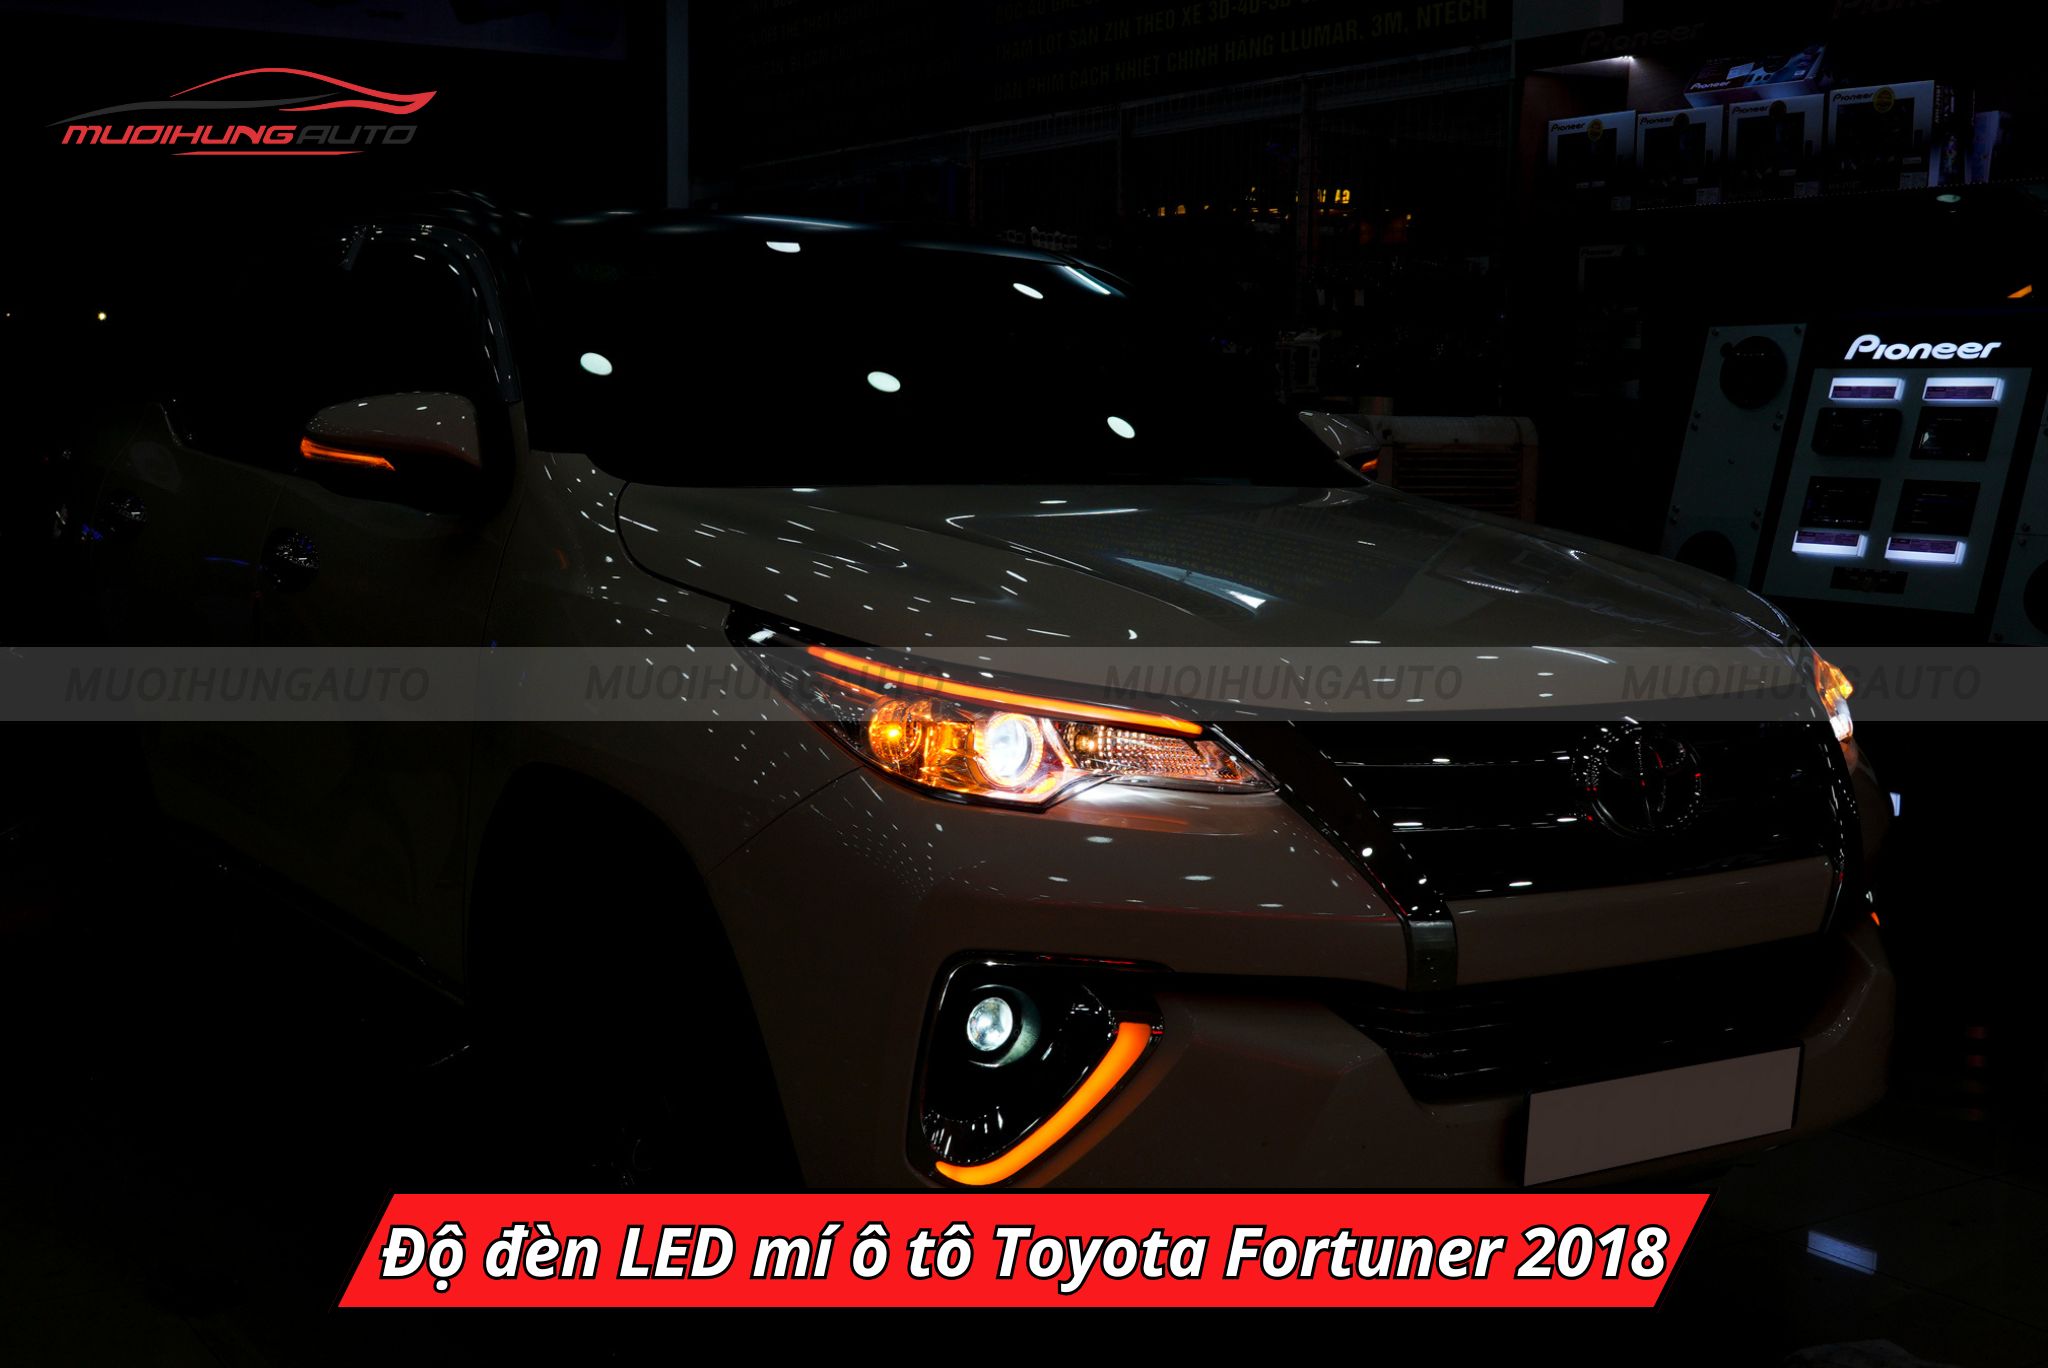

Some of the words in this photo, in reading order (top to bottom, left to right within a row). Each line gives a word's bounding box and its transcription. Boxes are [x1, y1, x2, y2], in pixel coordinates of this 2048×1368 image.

[1136, 9, 1175, 37] THEO
[1181, 4, 1202, 27] XE
[1417, 0, 1487, 30] NTECH
[1579, 22, 1705, 56] Pioneer
[1690, 81, 1732, 90] Pioneer
[1832, 93, 1874, 102] Pioneer
[1732, 106, 1769, 114] Pioneer
[1550, 123, 1585, 132] Pioneer
[1844, 334, 2002, 361] Pioneer
